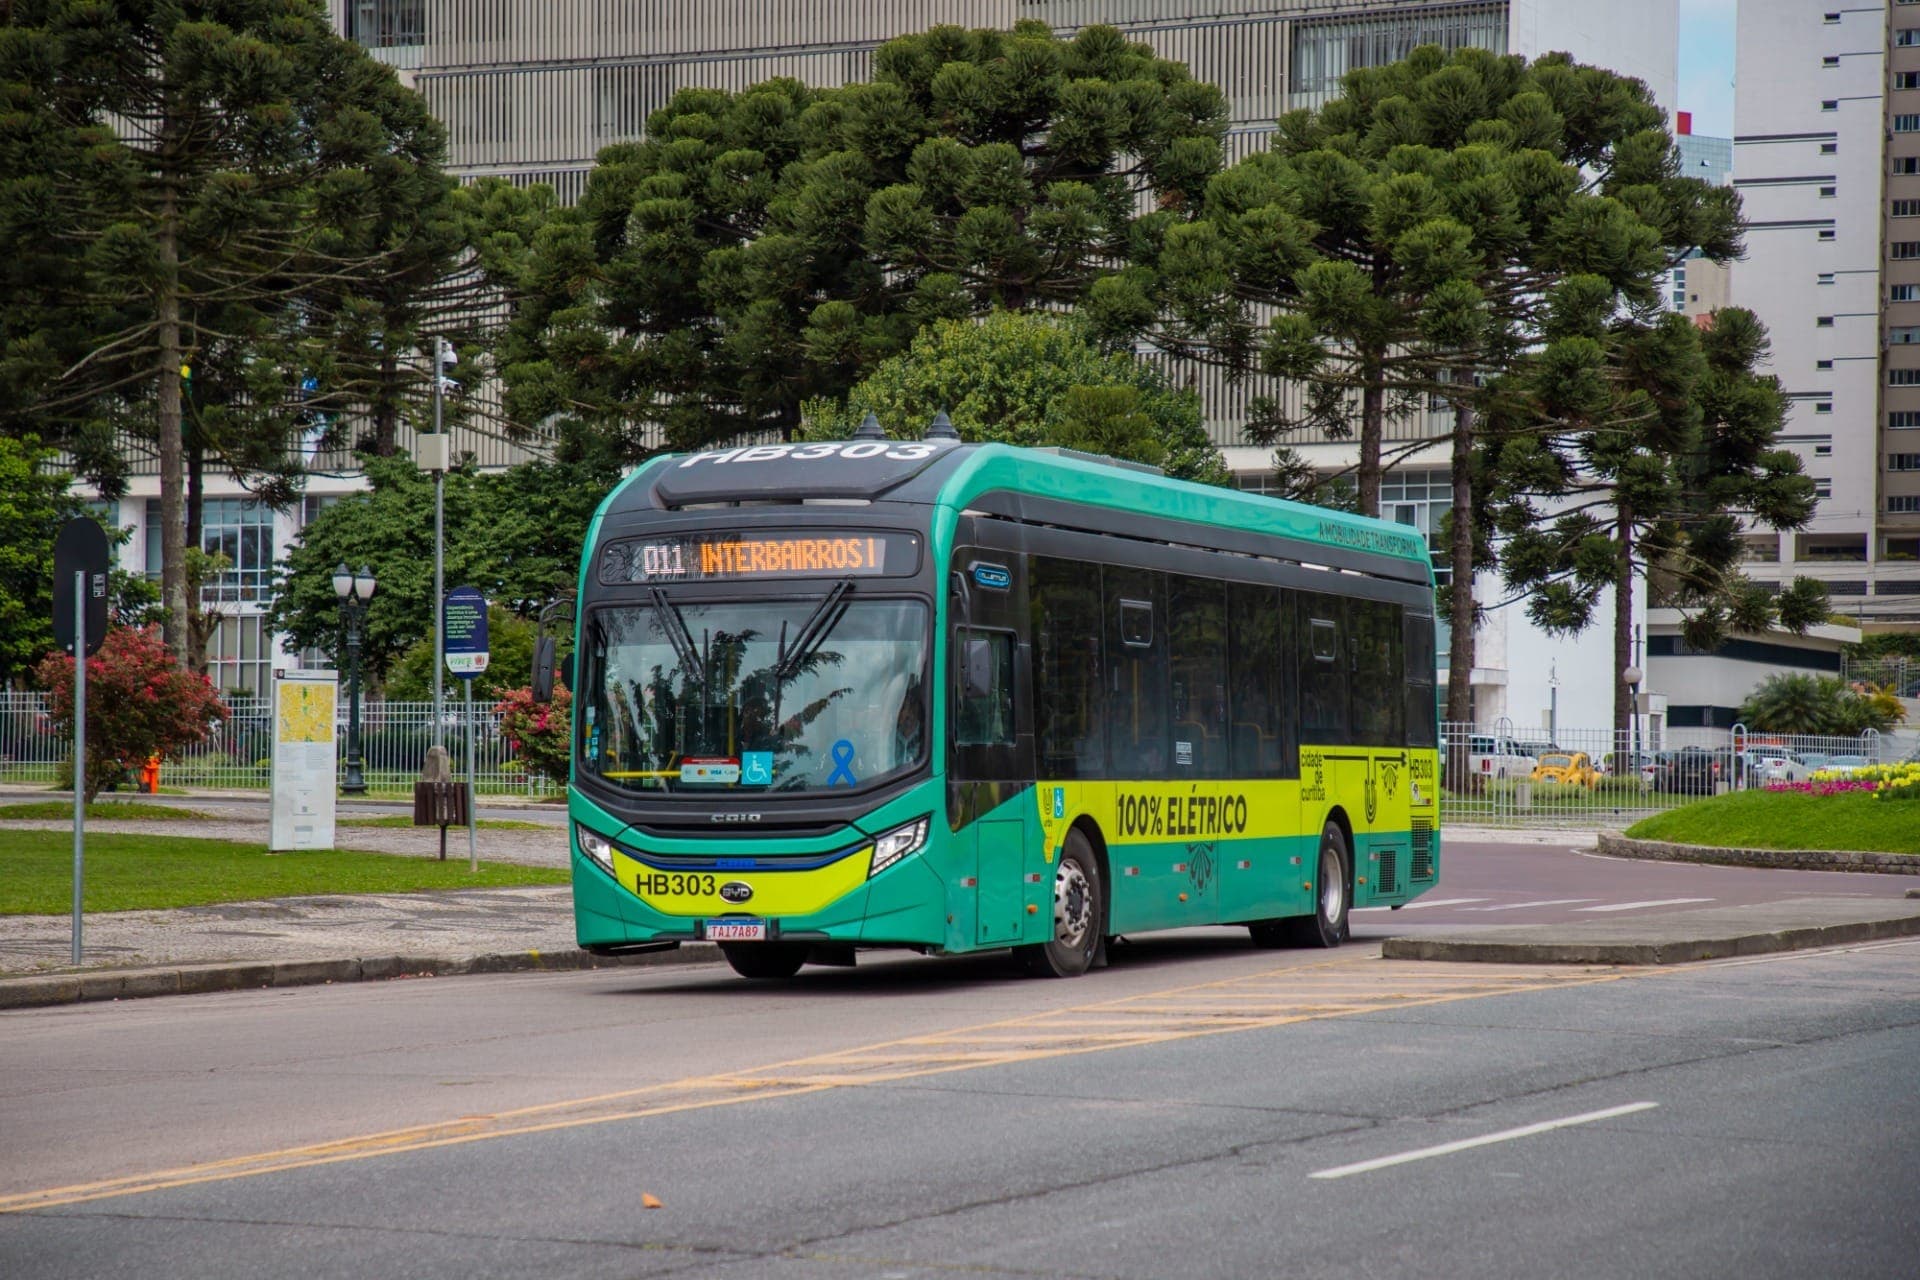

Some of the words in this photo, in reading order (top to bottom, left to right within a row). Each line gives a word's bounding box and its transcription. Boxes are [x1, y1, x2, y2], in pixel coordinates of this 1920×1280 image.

[679, 443, 936, 467] HB303
[1319, 520, 1325, 540] A
[1325, 523, 1370, 547] MOBILIDADE
[1371, 533, 1417, 554] TRANSFORMA
[643, 545, 686, 574] 011
[701, 539, 863, 573] INTERBAIRROS
[1301, 750, 1323, 767] cidade
[1410, 758, 1432, 780] HB303
[1314, 768, 1323, 784] de
[1301, 785, 1326, 801] curitiba
[1118, 794, 1162, 836] 100%
[1167, 784, 1247, 836] ELÉTRICO
[637, 874, 715, 896] HB303
[722, 887, 750, 897] BYD
